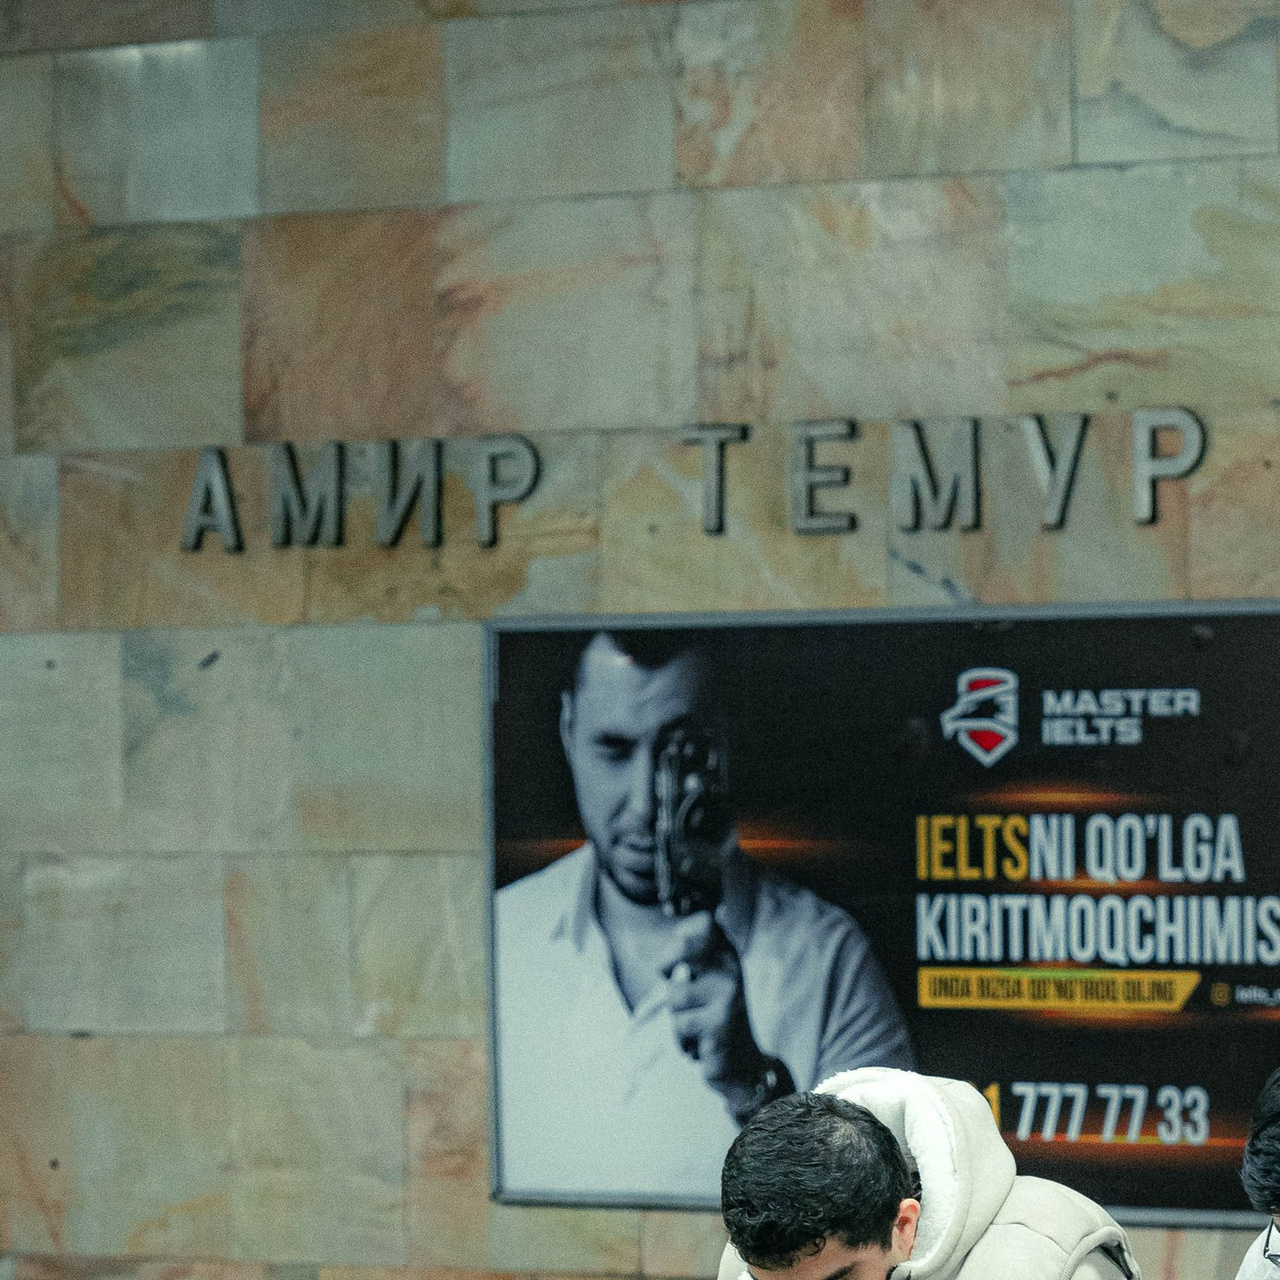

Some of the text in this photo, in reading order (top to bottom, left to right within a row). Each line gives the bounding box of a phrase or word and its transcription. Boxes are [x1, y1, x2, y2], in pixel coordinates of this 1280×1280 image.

[180, 432, 541, 553] АМИР
[685, 404, 1209, 537] ТЕМУР
[1041, 716, 1143, 745] IELTS
[1042, 688, 1200, 716] MASTER
[915, 813, 1246, 885] IELTSNI QO'LGA
[1011, 1081, 1088, 1141] 777
[1096, 1083, 1149, 1143] 77
[1156, 1085, 1210, 1146] 33
